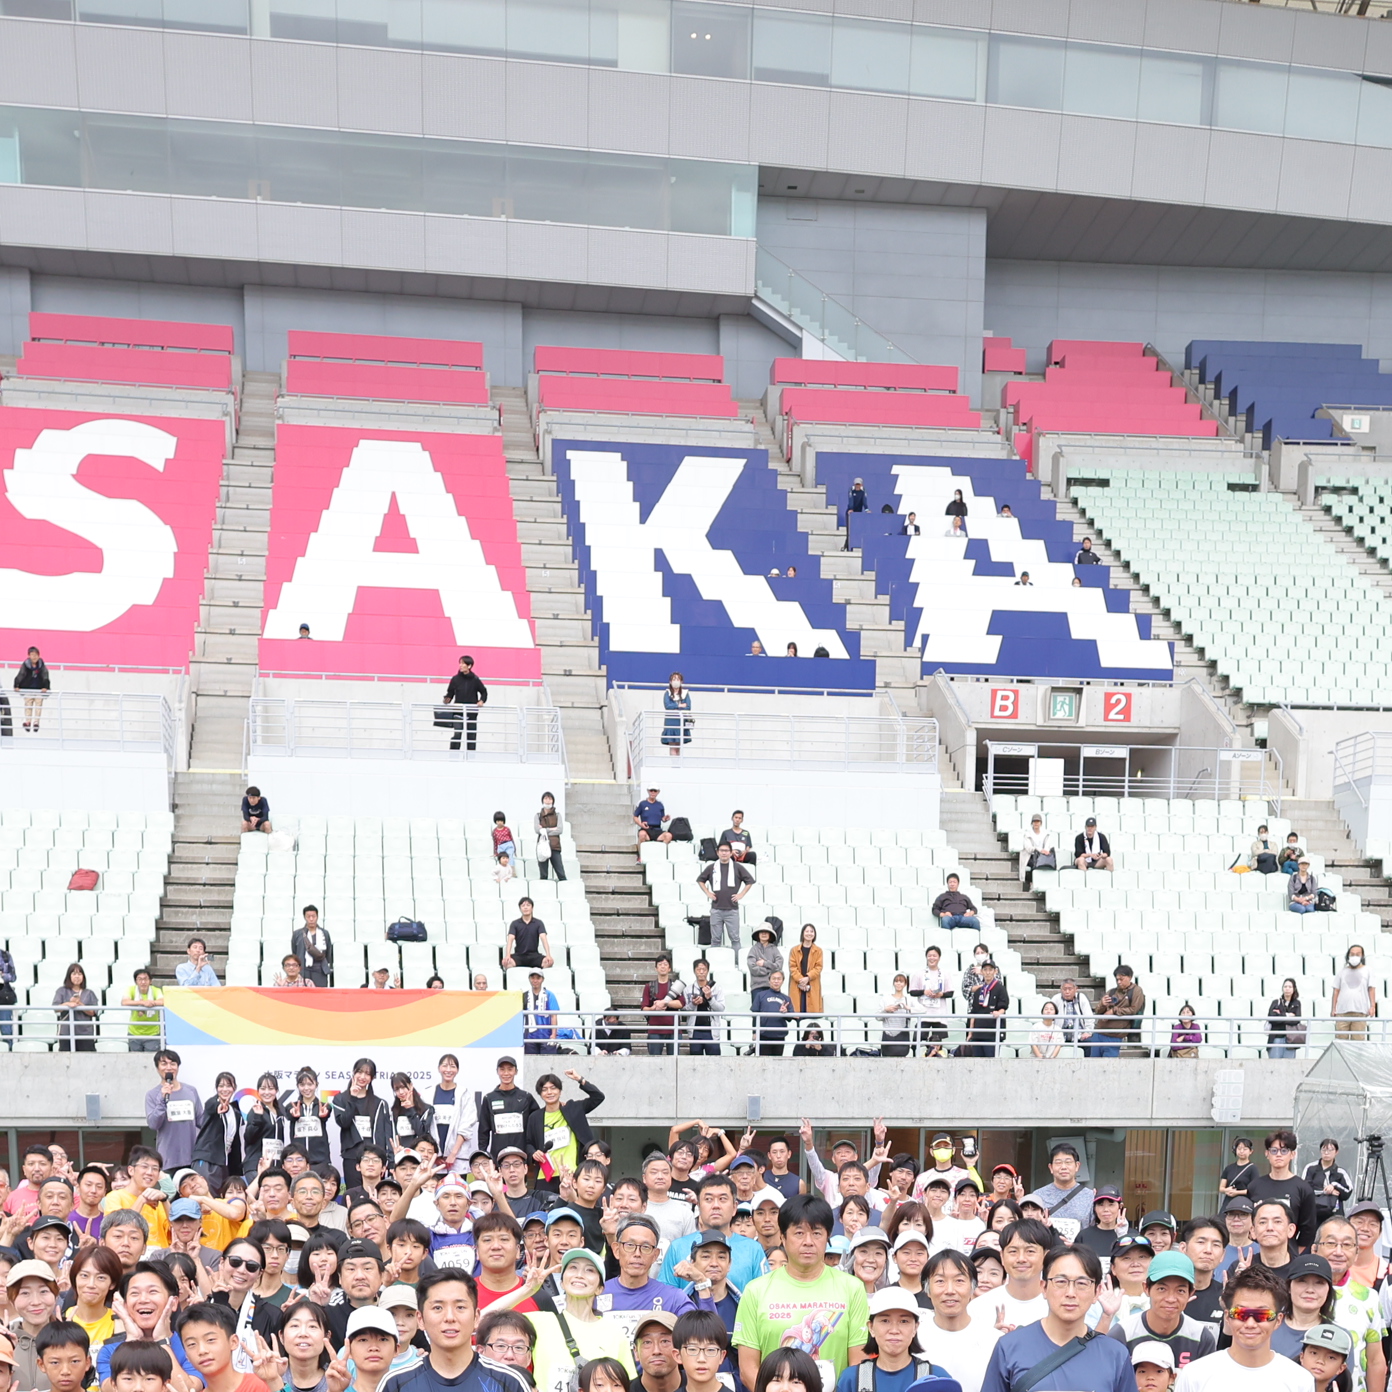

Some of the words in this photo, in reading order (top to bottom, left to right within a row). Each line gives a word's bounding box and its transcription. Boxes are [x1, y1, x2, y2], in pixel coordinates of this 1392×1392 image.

[993, 690, 1016, 717] B
[1107, 694, 1128, 720] 2
[408, 1070, 432, 1080] 2025
[1058, 1226, 1075, 1236] 255
[799, 1302, 846, 1310] MARATHON
[768, 1312, 792, 1320] 2025
